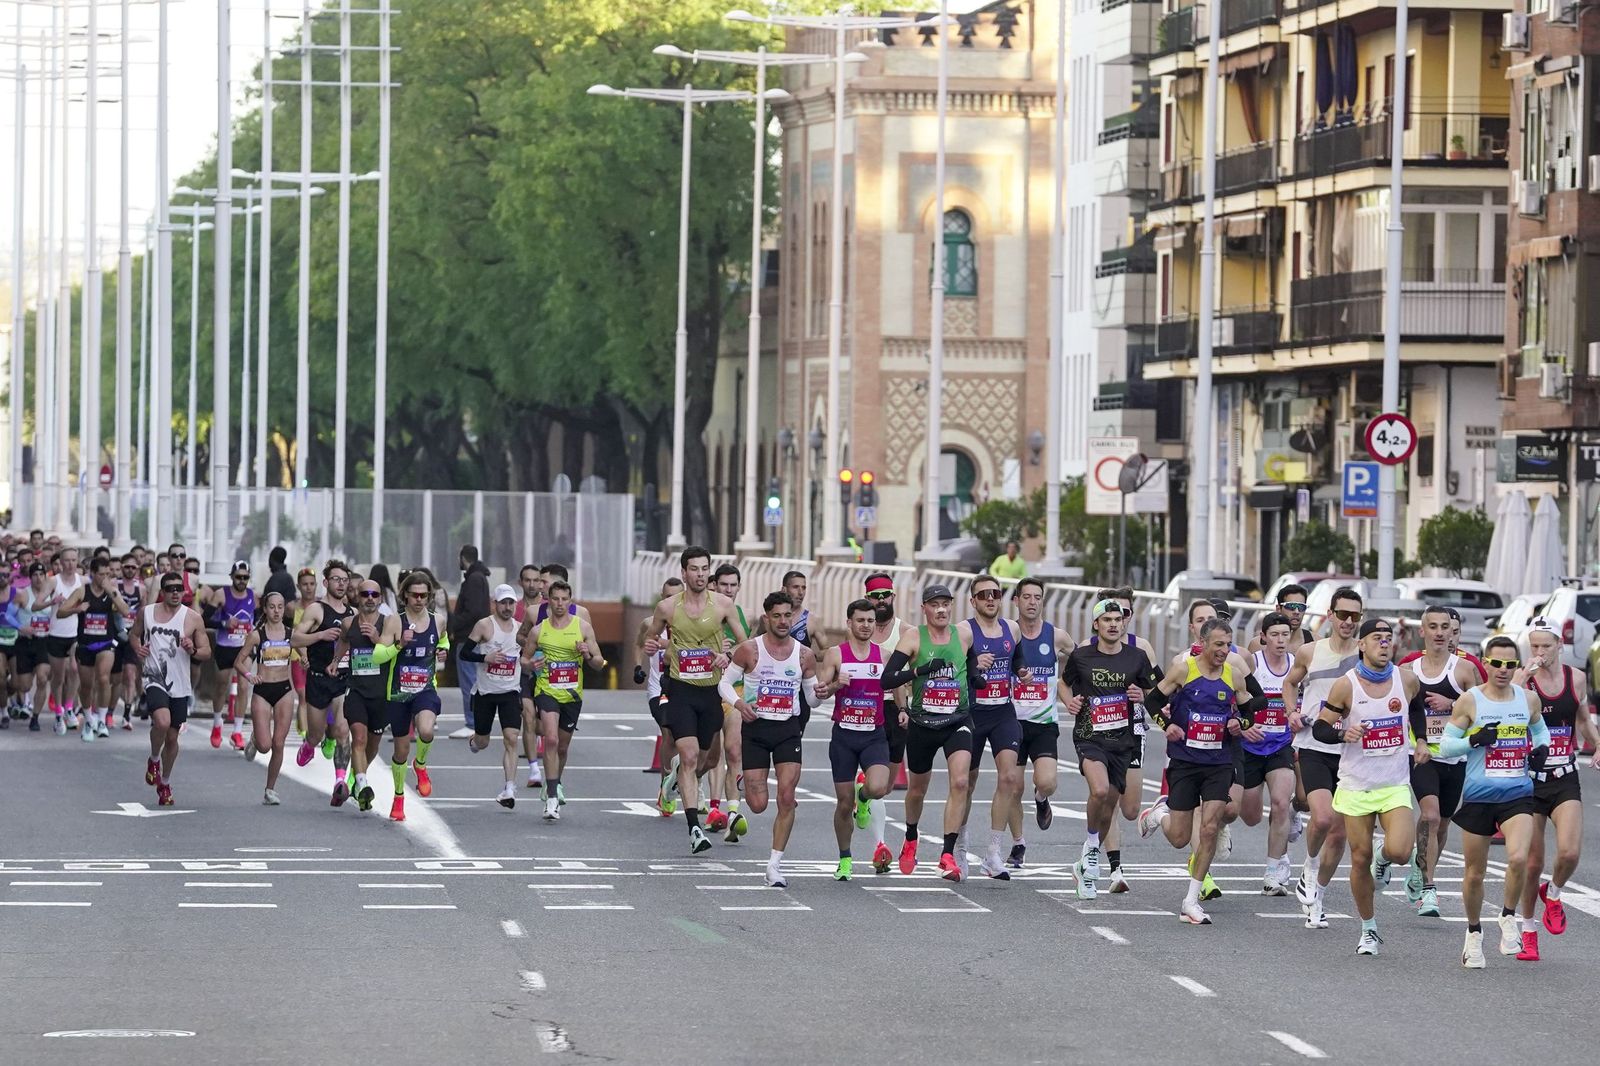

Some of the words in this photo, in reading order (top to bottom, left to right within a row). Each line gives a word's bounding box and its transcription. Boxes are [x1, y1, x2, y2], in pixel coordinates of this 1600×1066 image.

[1348, 466, 1371, 496] P
[1107, 672, 1126, 681] KM
[988, 688, 1001, 697] LÉO
[922, 698, 959, 706] SULLY-ALBA
[842, 714, 859, 724] JOSE
[860, 715, 875, 724] LUIS
[1097, 713, 1124, 723] CHANAL
[1264, 717, 1277, 725] JOE
[1376, 719, 1399, 727] ZURICH
[1197, 732, 1216, 741] MIMO
[1366, 736, 1401, 748] HOYALES
[1557, 746, 1566, 755] PJ
[1487, 759, 1509, 768] JOSE
[1510, 758, 1525, 768] LUIS
